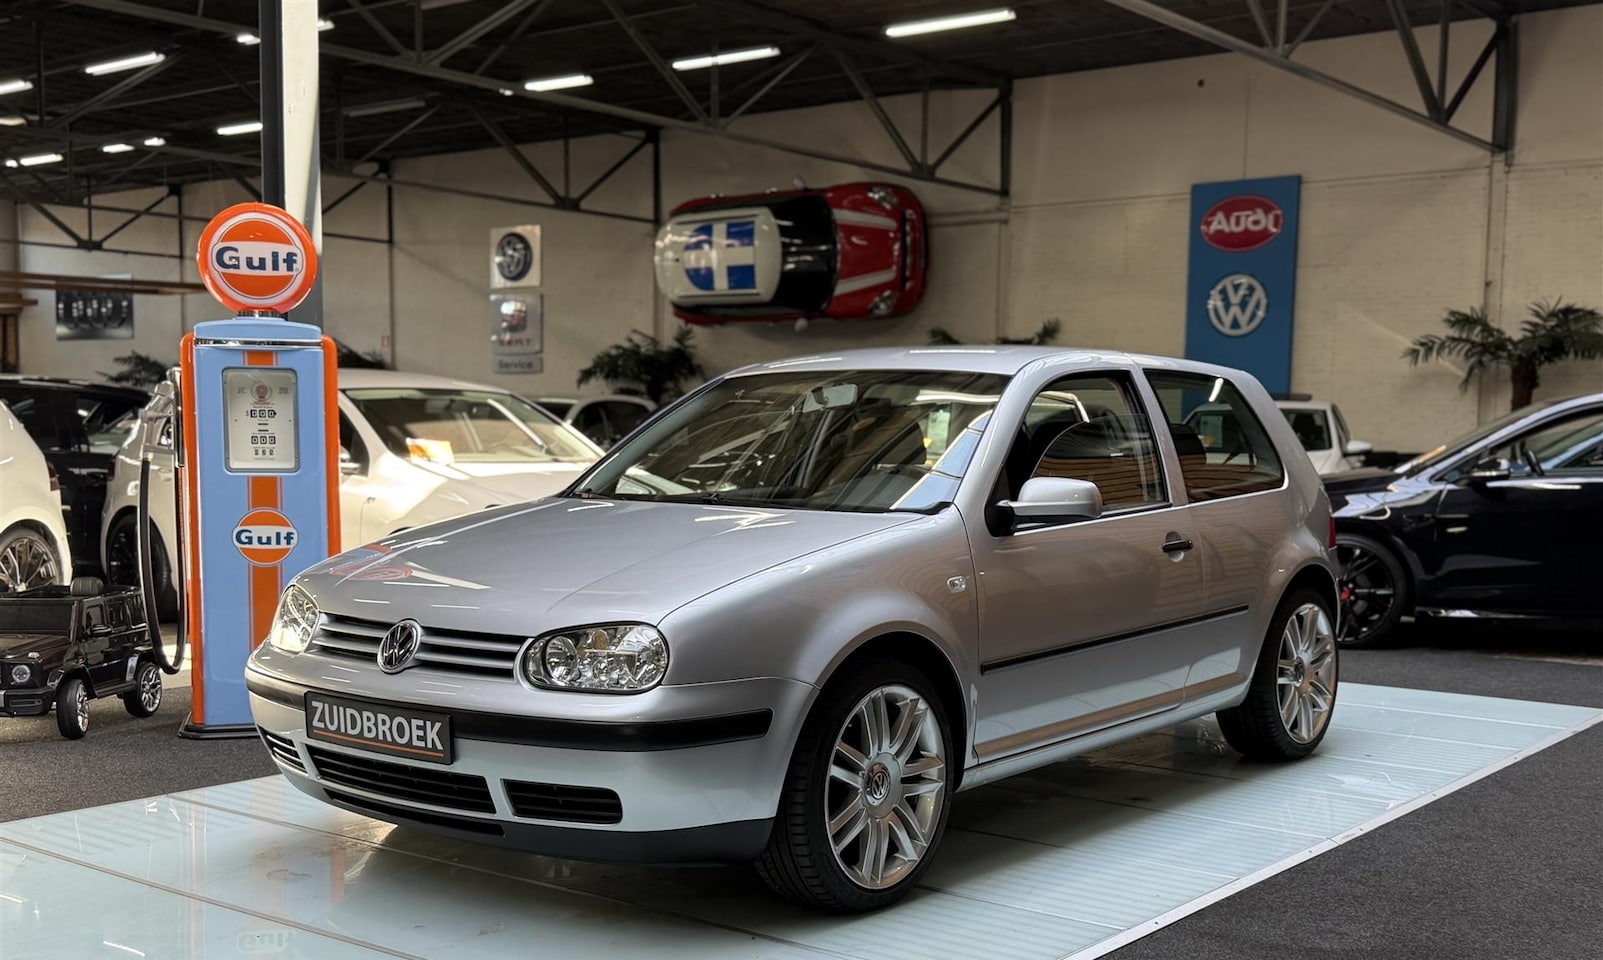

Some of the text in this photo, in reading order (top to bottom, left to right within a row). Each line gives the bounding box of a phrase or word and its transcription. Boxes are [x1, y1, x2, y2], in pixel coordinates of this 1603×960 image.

[215, 245, 298, 273] Gulf
[498, 359, 534, 370] Service
[235, 528, 295, 546] Gulf
[311, 700, 444, 751] ZUIDBROEK
